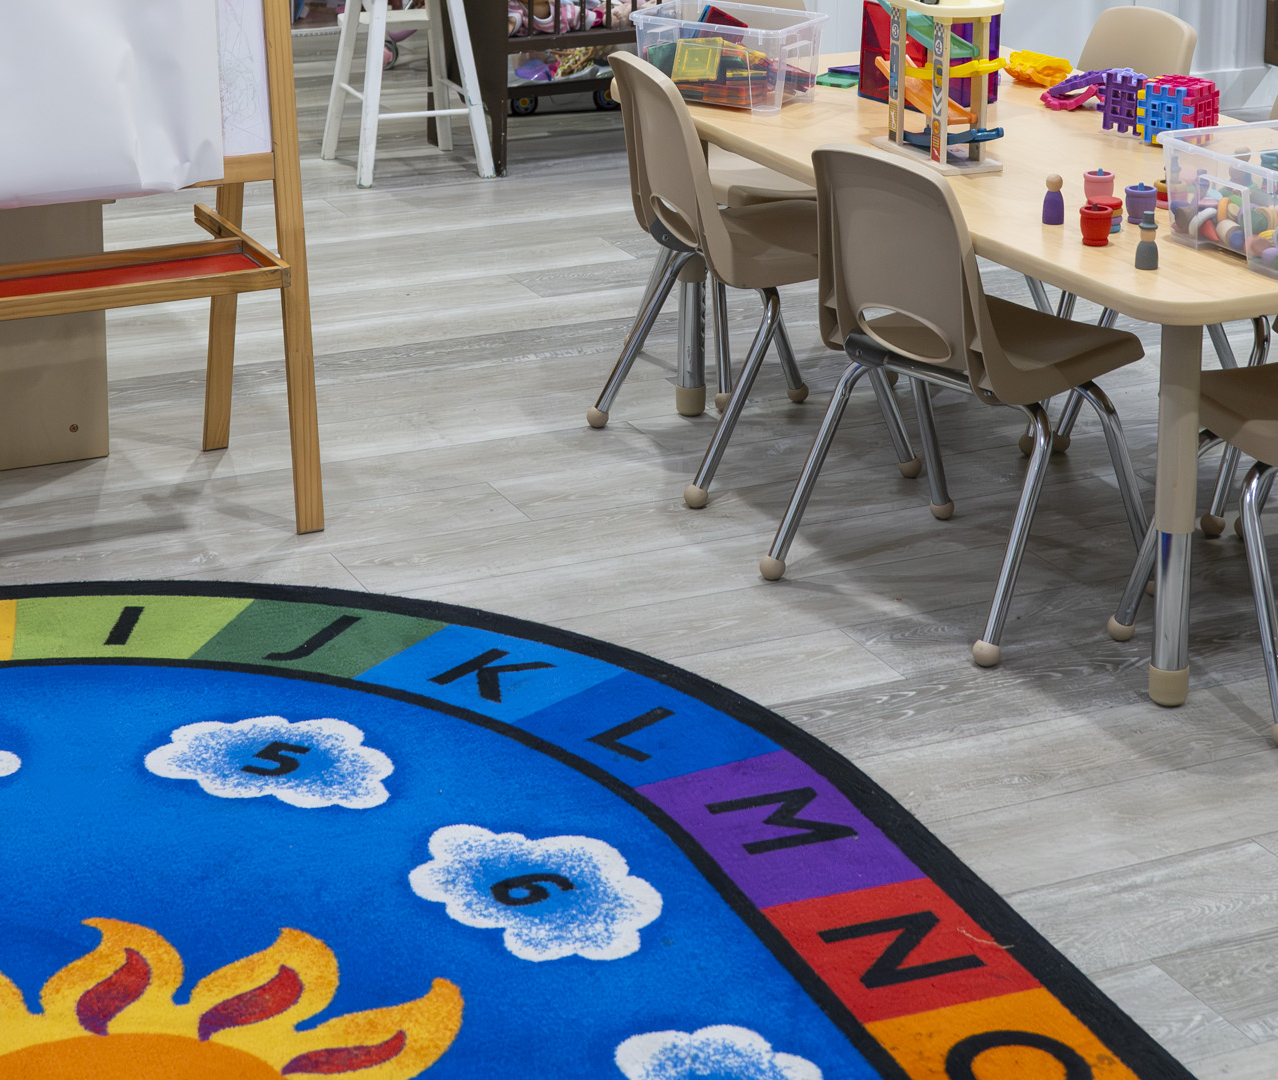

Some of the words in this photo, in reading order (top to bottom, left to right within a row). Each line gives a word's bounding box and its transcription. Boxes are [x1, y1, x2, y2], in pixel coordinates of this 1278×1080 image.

[102, 606, 145, 647] I
[265, 615, 362, 663] J
[429, 647, 558, 703] K
[242, 741, 311, 778] 5
[590, 705, 678, 763] L
[706, 786, 862, 856] M
[489, 871, 577, 907] 6
[816, 910, 987, 990] N
